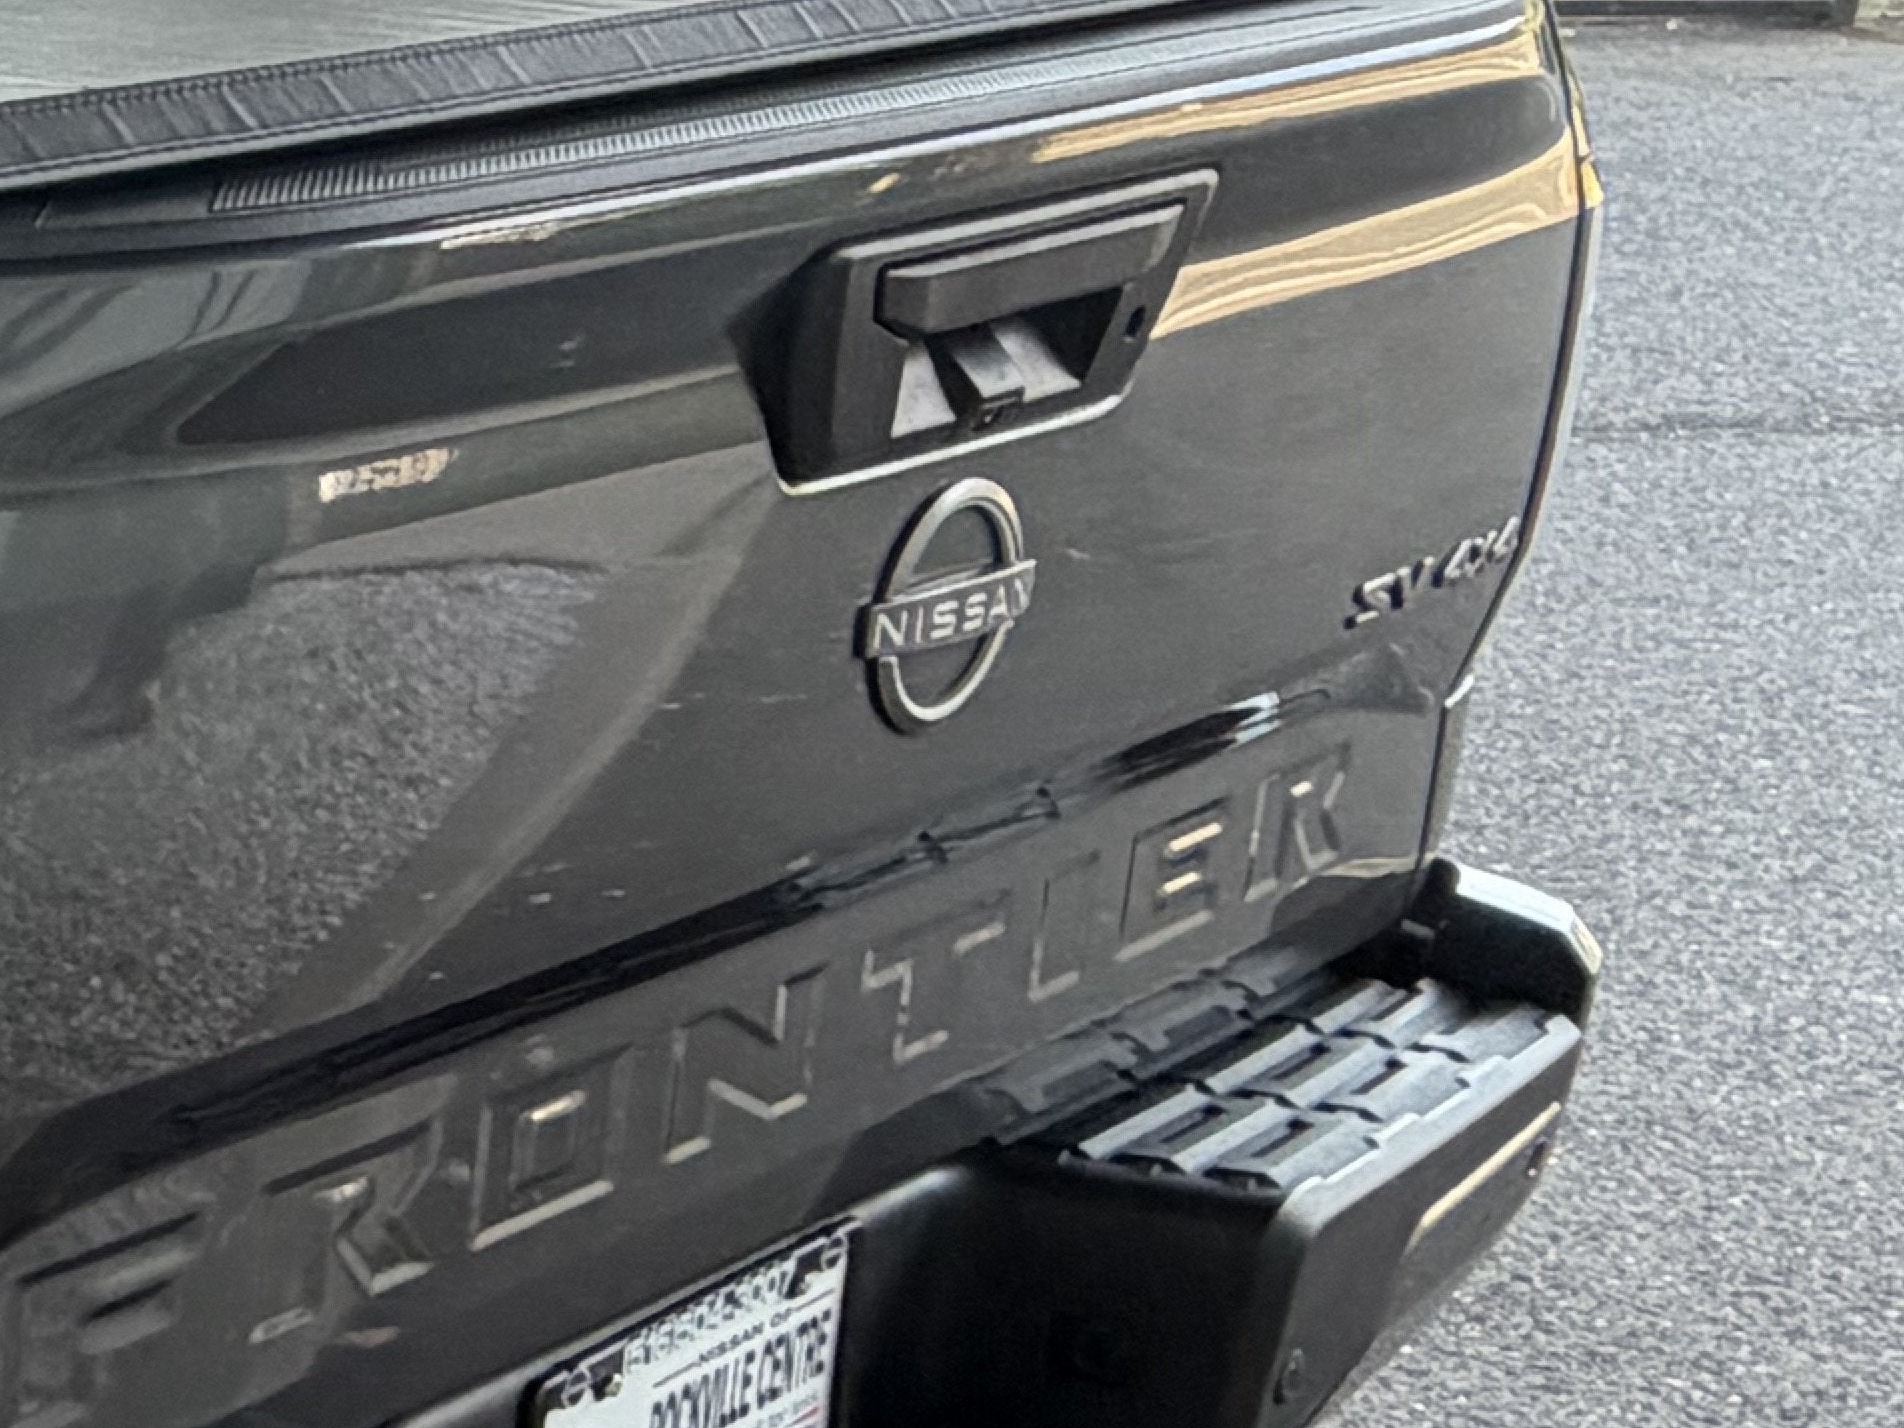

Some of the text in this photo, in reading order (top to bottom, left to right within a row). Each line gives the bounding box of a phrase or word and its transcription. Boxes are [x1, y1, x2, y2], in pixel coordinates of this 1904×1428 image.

[873, 576, 1032, 652] NISSAN
[697, 1321, 765, 1366] NISSAN
[755, 1307, 833, 1410] CENTRE
